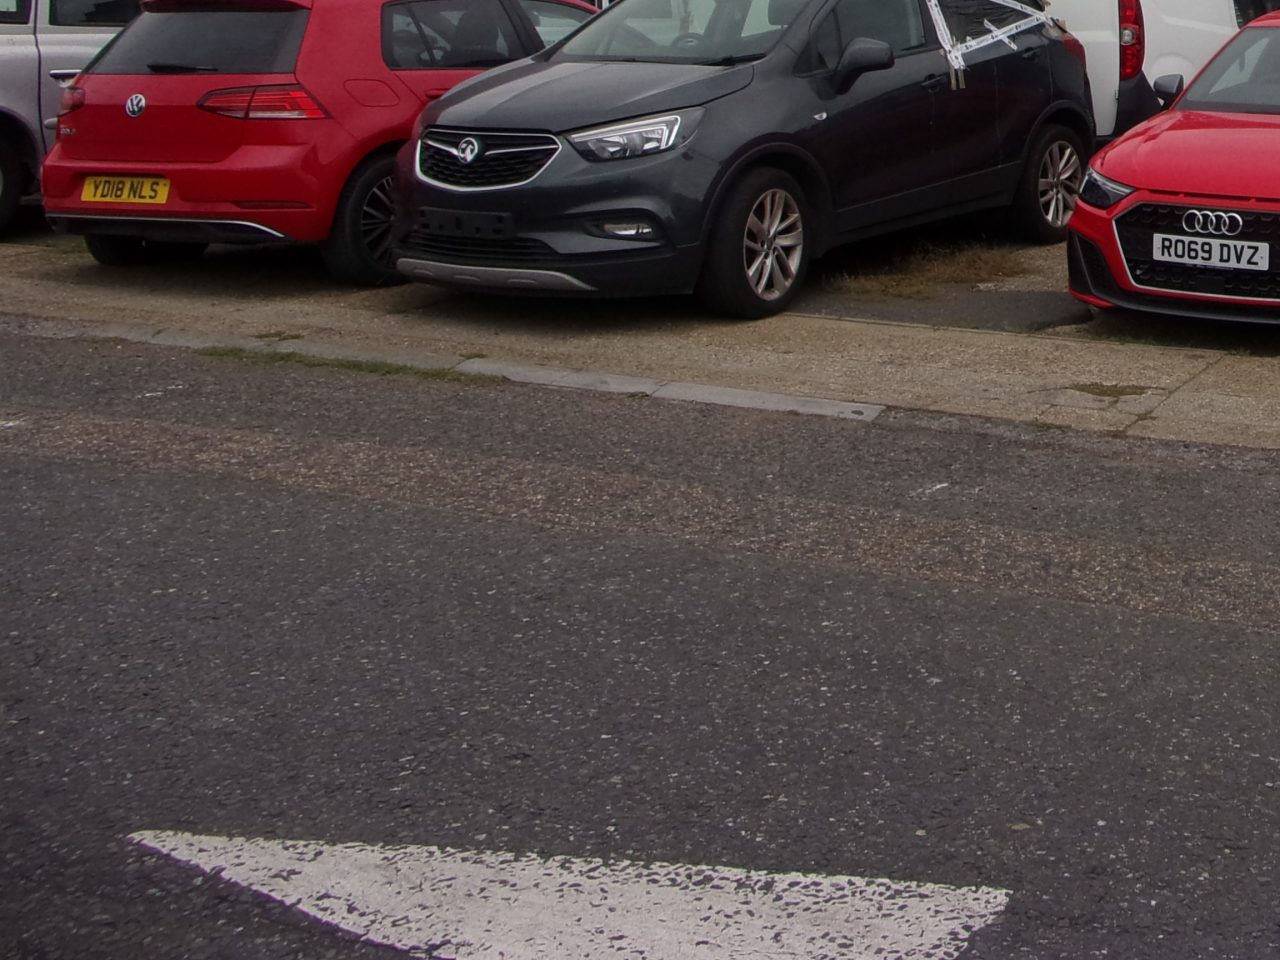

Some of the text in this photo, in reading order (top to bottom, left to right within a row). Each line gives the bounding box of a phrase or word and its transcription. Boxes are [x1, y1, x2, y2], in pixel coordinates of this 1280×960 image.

[92, 179, 160, 200] YD18 NLS
[1160, 237, 1260, 266] RO69 DVZ
